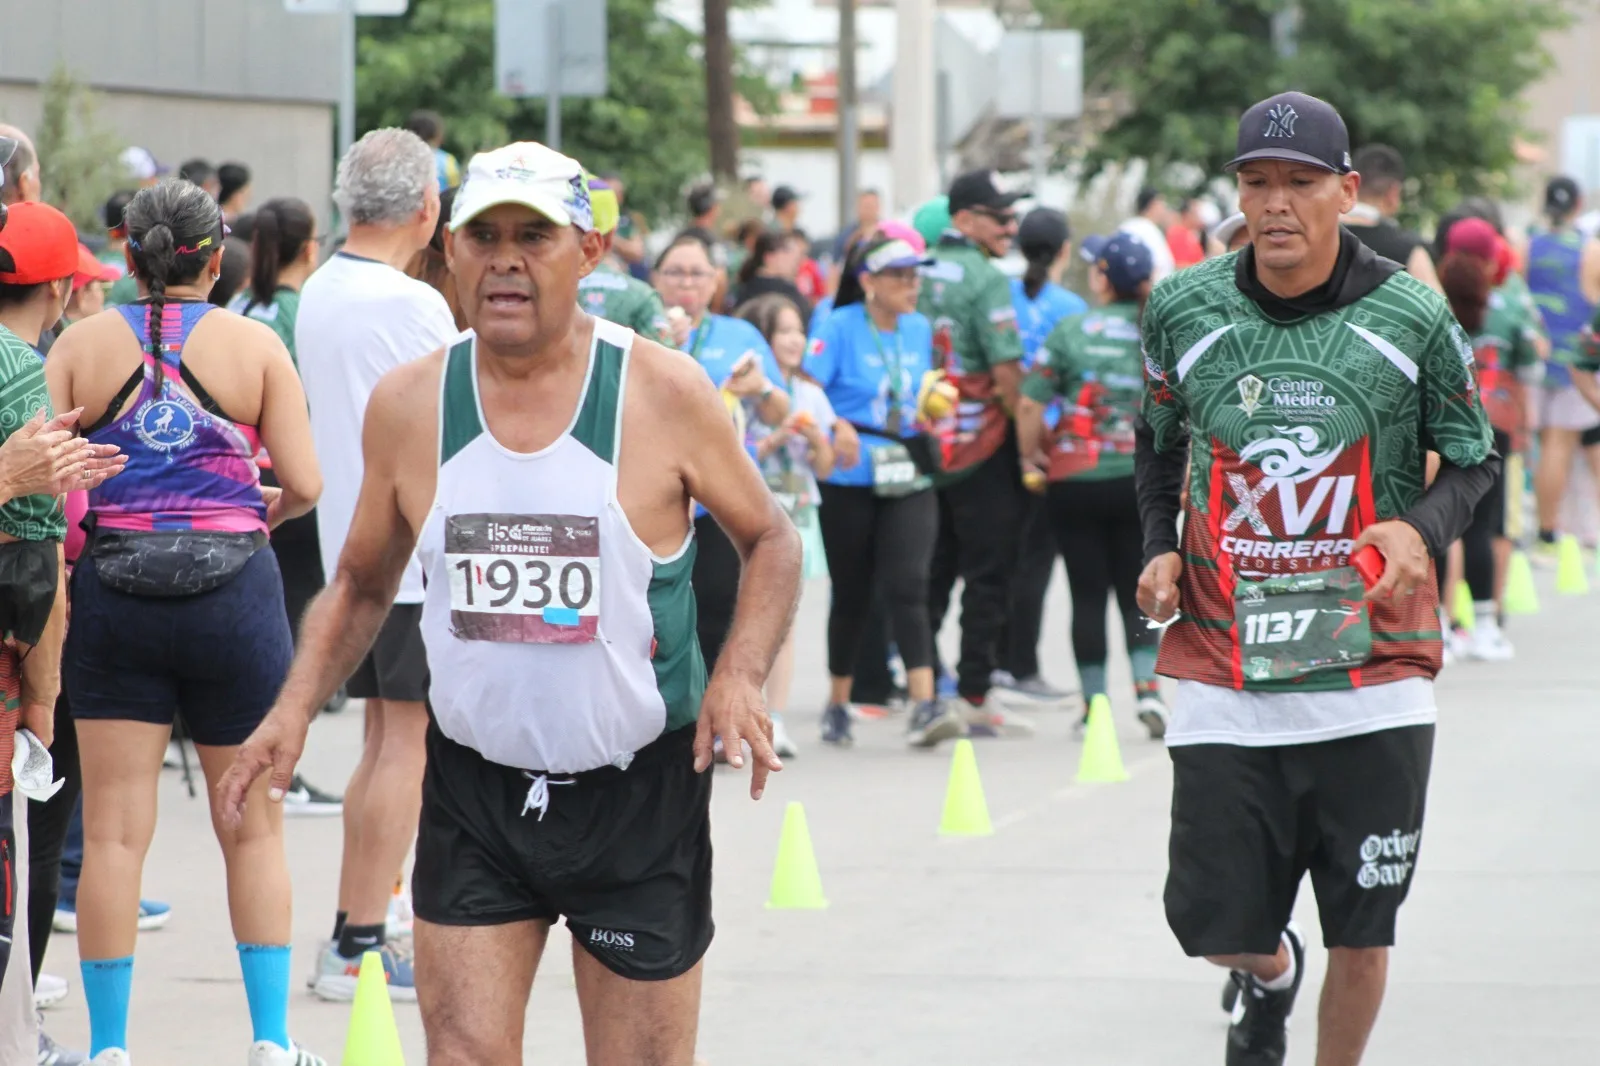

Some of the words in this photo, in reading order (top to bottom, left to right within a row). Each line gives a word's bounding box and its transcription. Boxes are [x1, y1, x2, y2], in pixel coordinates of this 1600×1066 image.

[1267, 377, 1323, 392] Centro
[1273, 391, 1336, 406] Médico
[1221, 471, 1356, 537] XVI
[1220, 535, 1355, 559] CARRERA
[455, 559, 593, 610] 1930
[1244, 609, 1318, 645] 1137
[589, 928, 635, 947] BOSS
